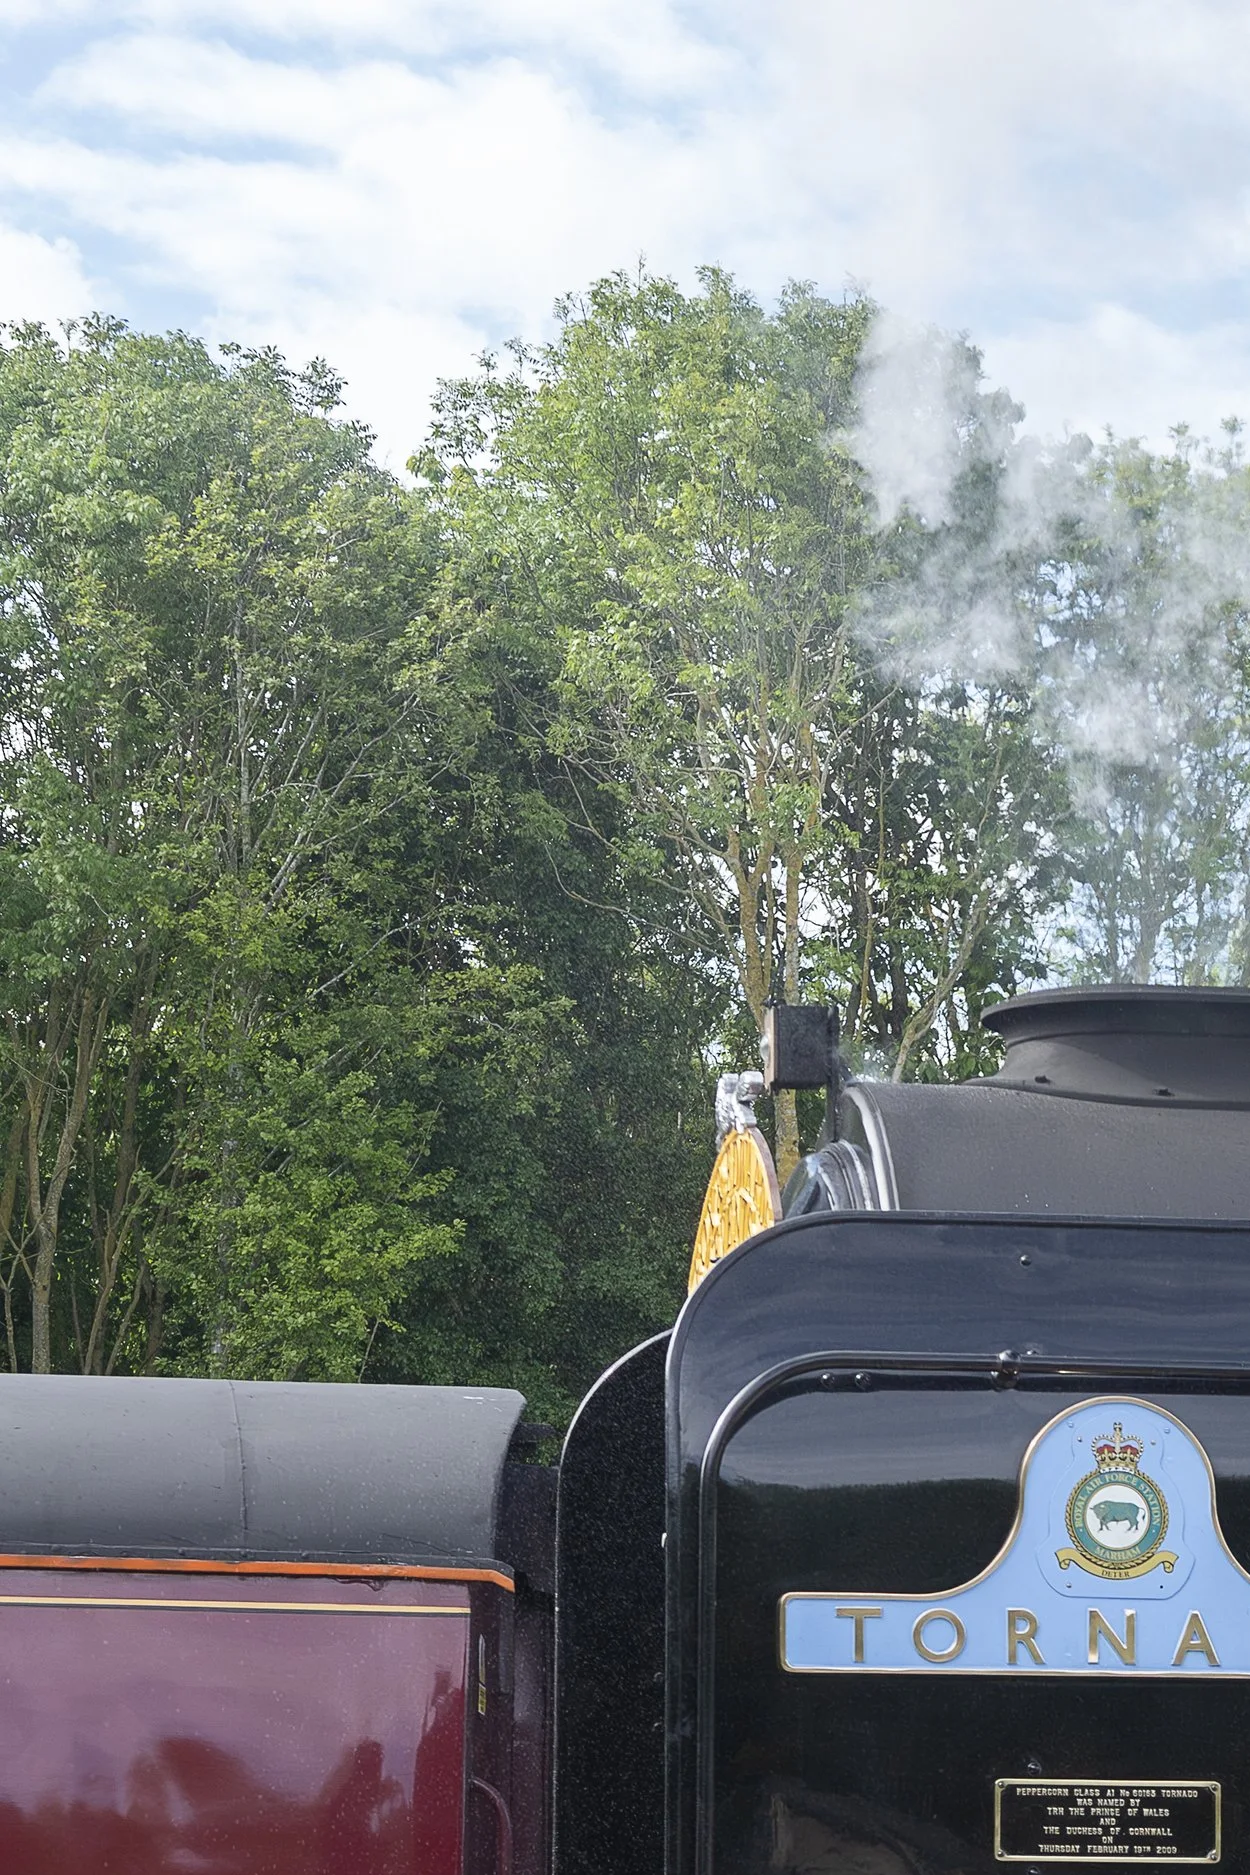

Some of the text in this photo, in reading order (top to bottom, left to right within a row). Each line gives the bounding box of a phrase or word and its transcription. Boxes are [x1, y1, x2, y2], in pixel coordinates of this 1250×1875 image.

[1074, 1473, 1161, 1528] ROYAL AIR FORCE STATION
[1095, 1546, 1141, 1560] MARHAM
[1101, 1570, 1130, 1578] DETER
[1016, 1787, 1069, 1797] PEPPERCORN
[1073, 1788, 1101, 1797] CLASS
[1132, 1789, 1157, 1798] 60163
[1160, 1789, 1199, 1798] TORNADO
[1076, 1798, 1141, 1807] WAS NAMED BY
[1046, 1807, 1170, 1817] TRH THE PRINCE OF WALES
[1099, 1817, 1117, 1826] AND
[1043, 1826, 1060, 1835] THE
[1066, 1826, 1103, 1835] DUCHESS
[1128, 1827, 1173, 1836] CORNWALL
[1101, 1836, 1114, 1844] ON
[1038, 1844, 1081, 1853] THURSDAY
[1086, 1845, 1130, 1854] FEBRUARY
[1156, 1845, 1178, 1854] 2009
